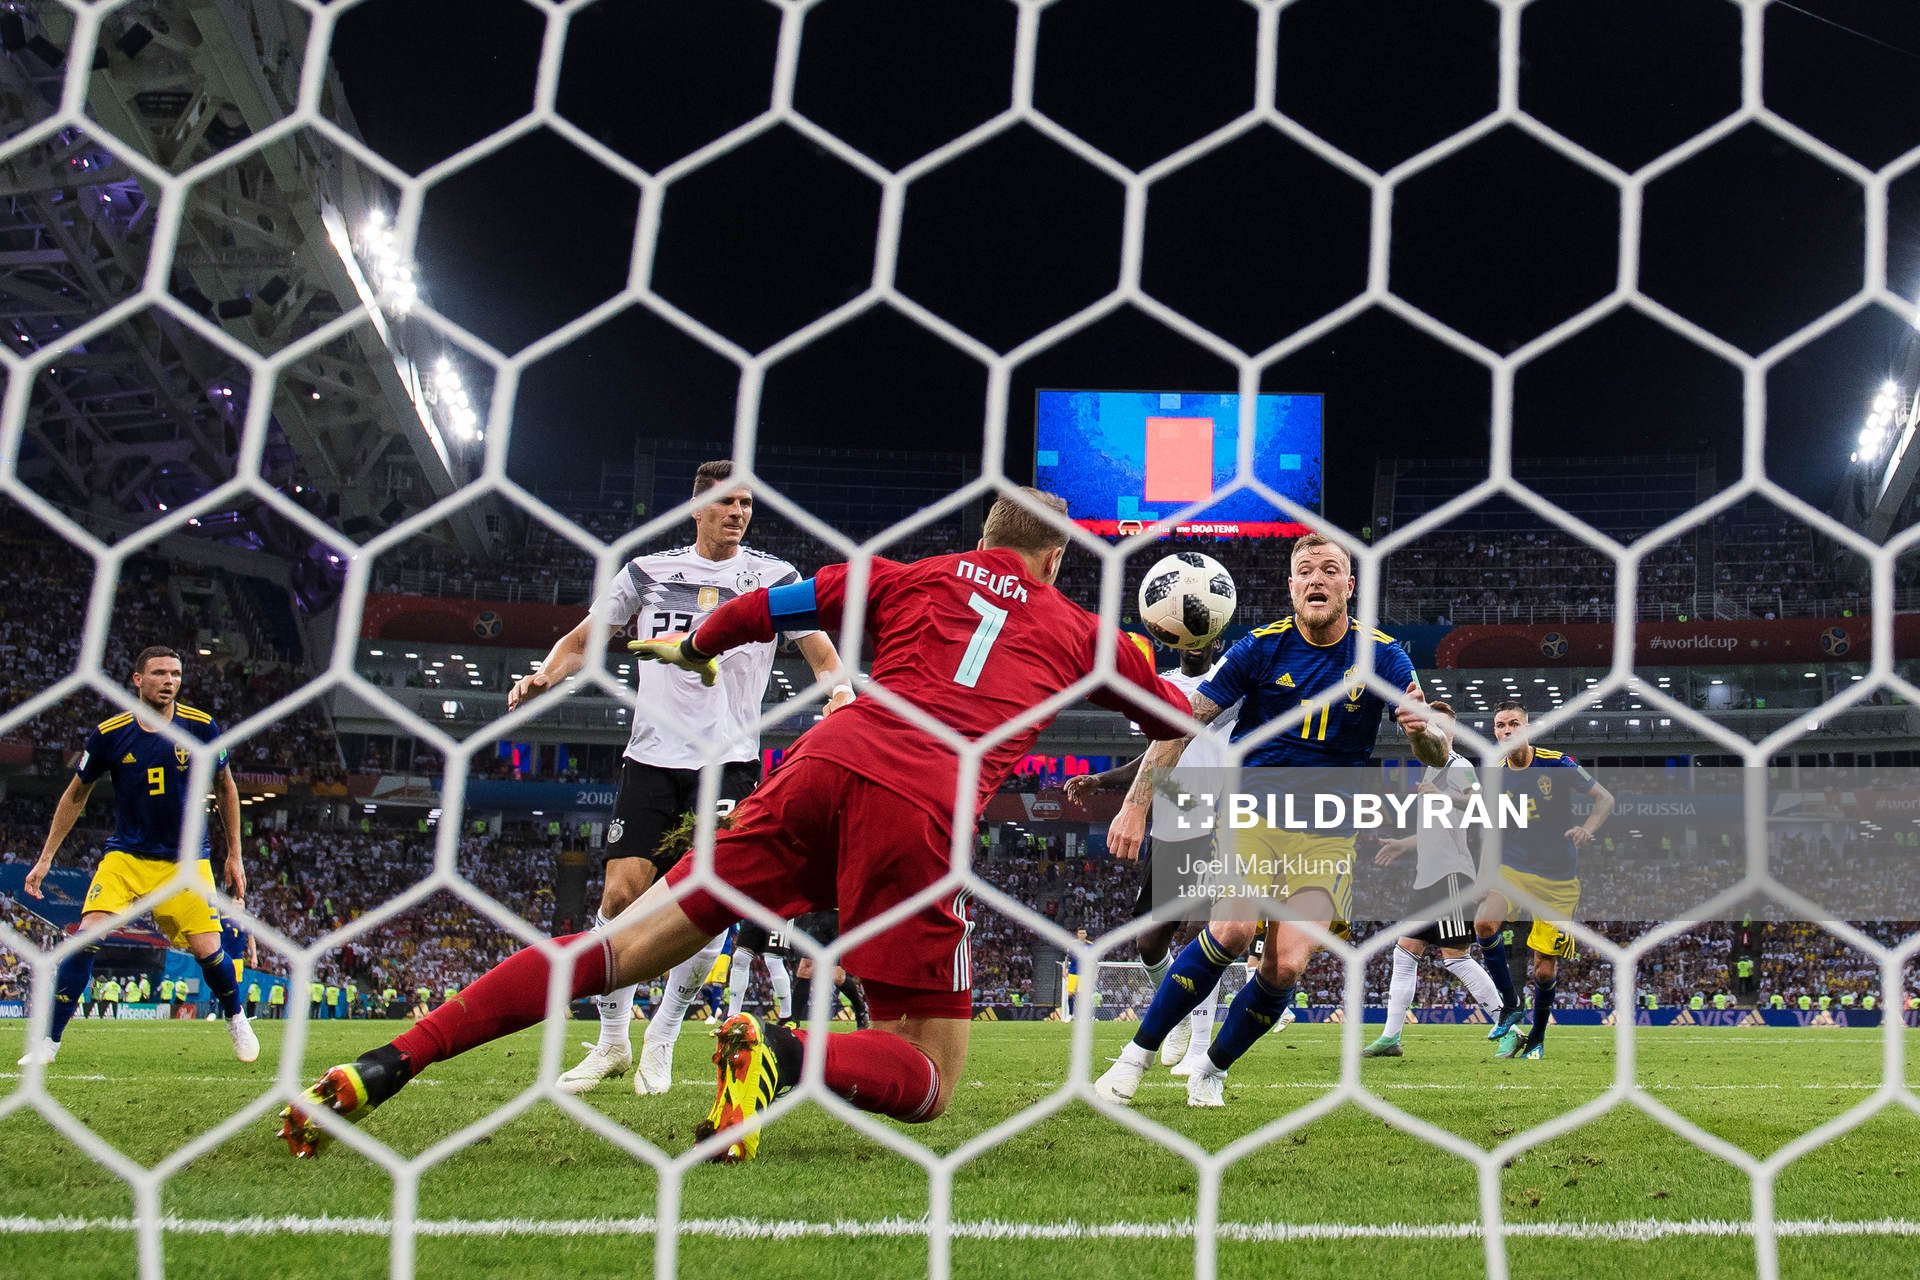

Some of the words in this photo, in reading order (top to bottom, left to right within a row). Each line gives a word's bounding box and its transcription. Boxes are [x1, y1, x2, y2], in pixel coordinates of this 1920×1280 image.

[1191, 524, 1239, 533] BOATENG
[956, 560, 1028, 603] NEUER
[953, 591, 1008, 688] 1
[1650, 634, 1738, 651] #worldcup
[1301, 699, 1330, 741] 11
[147, 766, 166, 796] 9
[576, 791, 614, 805] 2018
[1875, 796, 1920, 811] #wor
[1612, 803, 1633, 816] UP
[1637, 803, 1697, 816] RUSSIA
[117, 1004, 158, 1019] Hisense
